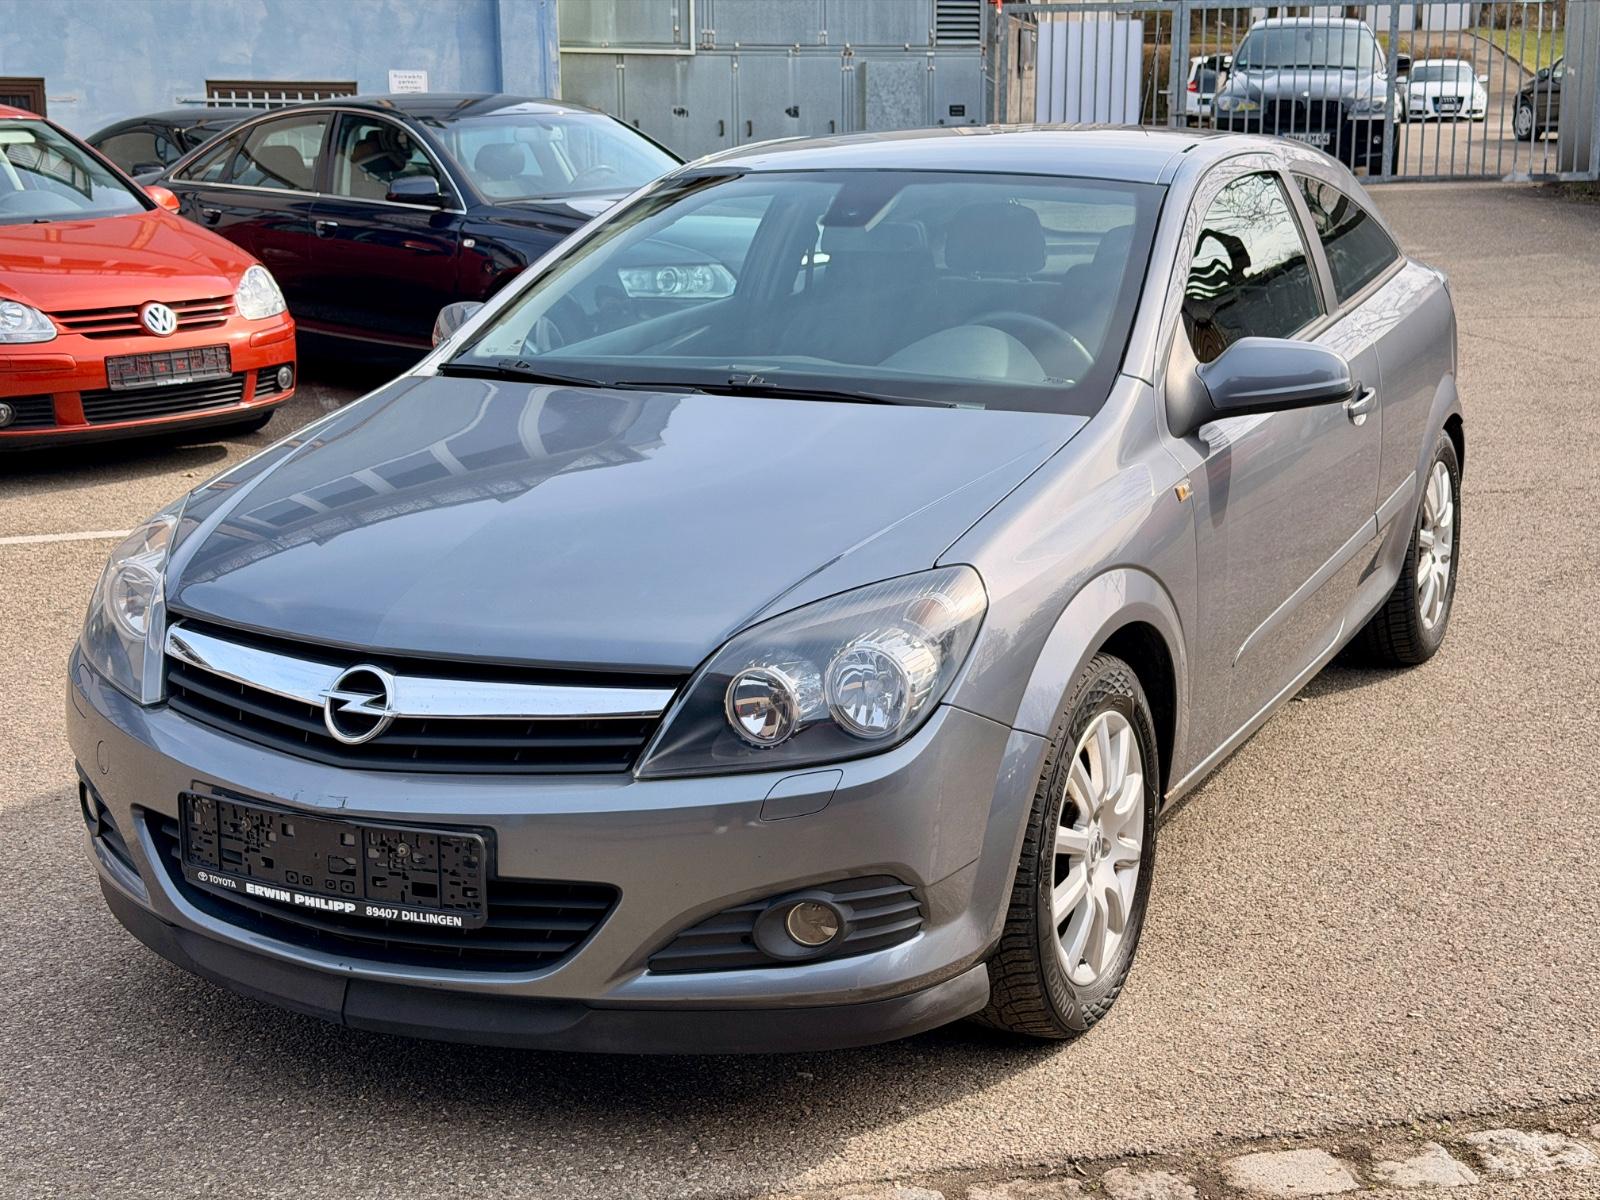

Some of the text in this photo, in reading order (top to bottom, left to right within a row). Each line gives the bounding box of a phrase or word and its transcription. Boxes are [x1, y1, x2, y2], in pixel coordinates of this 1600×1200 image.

[209, 874, 462, 927] TOYOTA ERWIN PHILIPP 89407 DILLINGEN
